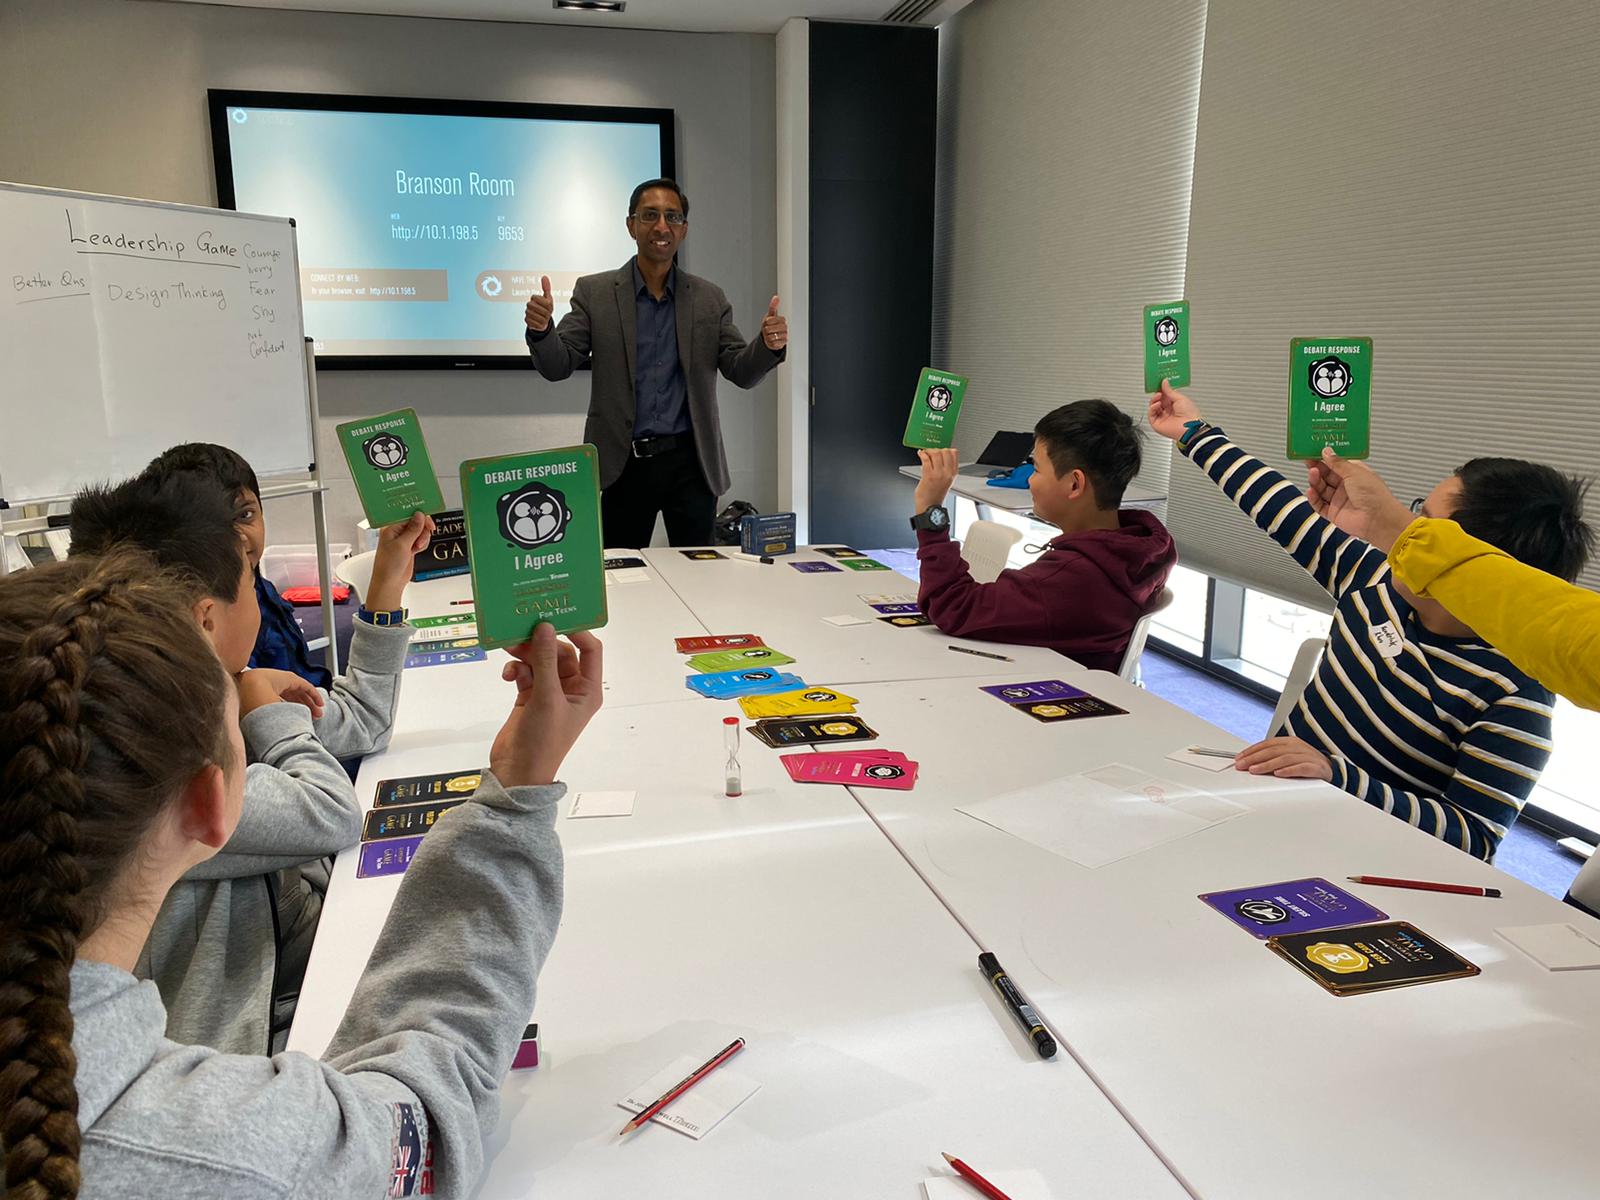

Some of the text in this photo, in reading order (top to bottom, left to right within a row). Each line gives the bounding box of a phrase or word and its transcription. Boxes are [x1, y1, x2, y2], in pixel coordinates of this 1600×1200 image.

[396, 169, 515, 197] Branson Room
[65, 208, 237, 258] Leadership Game
[391, 224, 479, 241] http://10.1.198.5
[497, 225, 524, 241] 9653
[108, 281, 227, 310] Design Thinking
[249, 280, 277, 296] Fear
[252, 304, 276, 323] Shy
[1303, 345, 1361, 354] DEBATE RESPONSE
[1314, 401, 1345, 414] I Agree
[351, 418, 406, 437] DEBATE RESPONSE
[379, 470, 410, 483] I Agree
[484, 461, 578, 485] DEBATE RESPONSE
[433, 541, 464, 561] GA
[514, 552, 564, 570] I Agree
